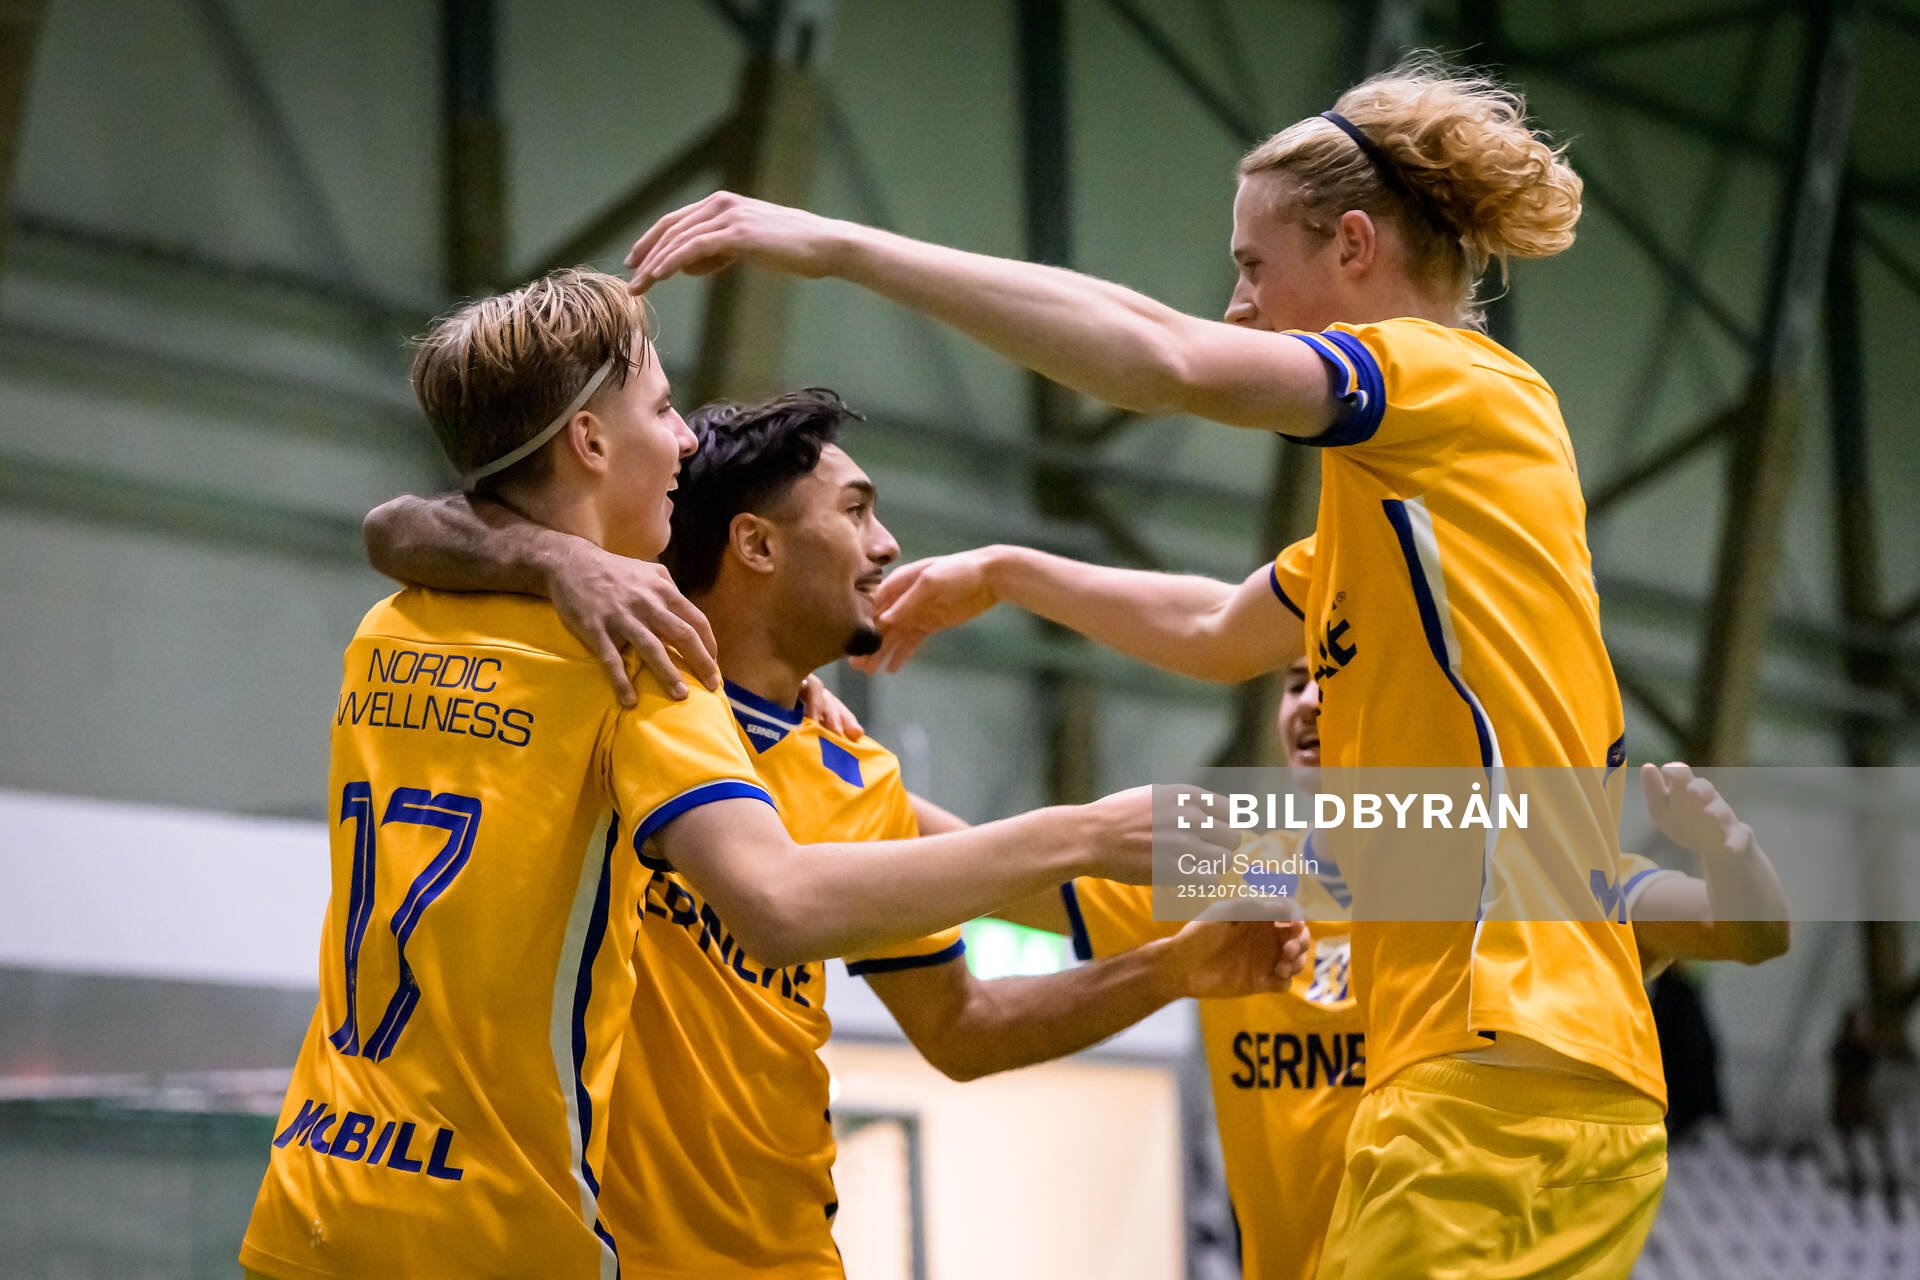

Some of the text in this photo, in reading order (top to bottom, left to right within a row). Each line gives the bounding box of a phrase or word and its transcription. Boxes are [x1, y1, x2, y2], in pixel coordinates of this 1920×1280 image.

[367, 648, 502, 693] NORDIC
[337, 691, 535, 748] WELLNESS
[328, 780, 483, 1064] 17
